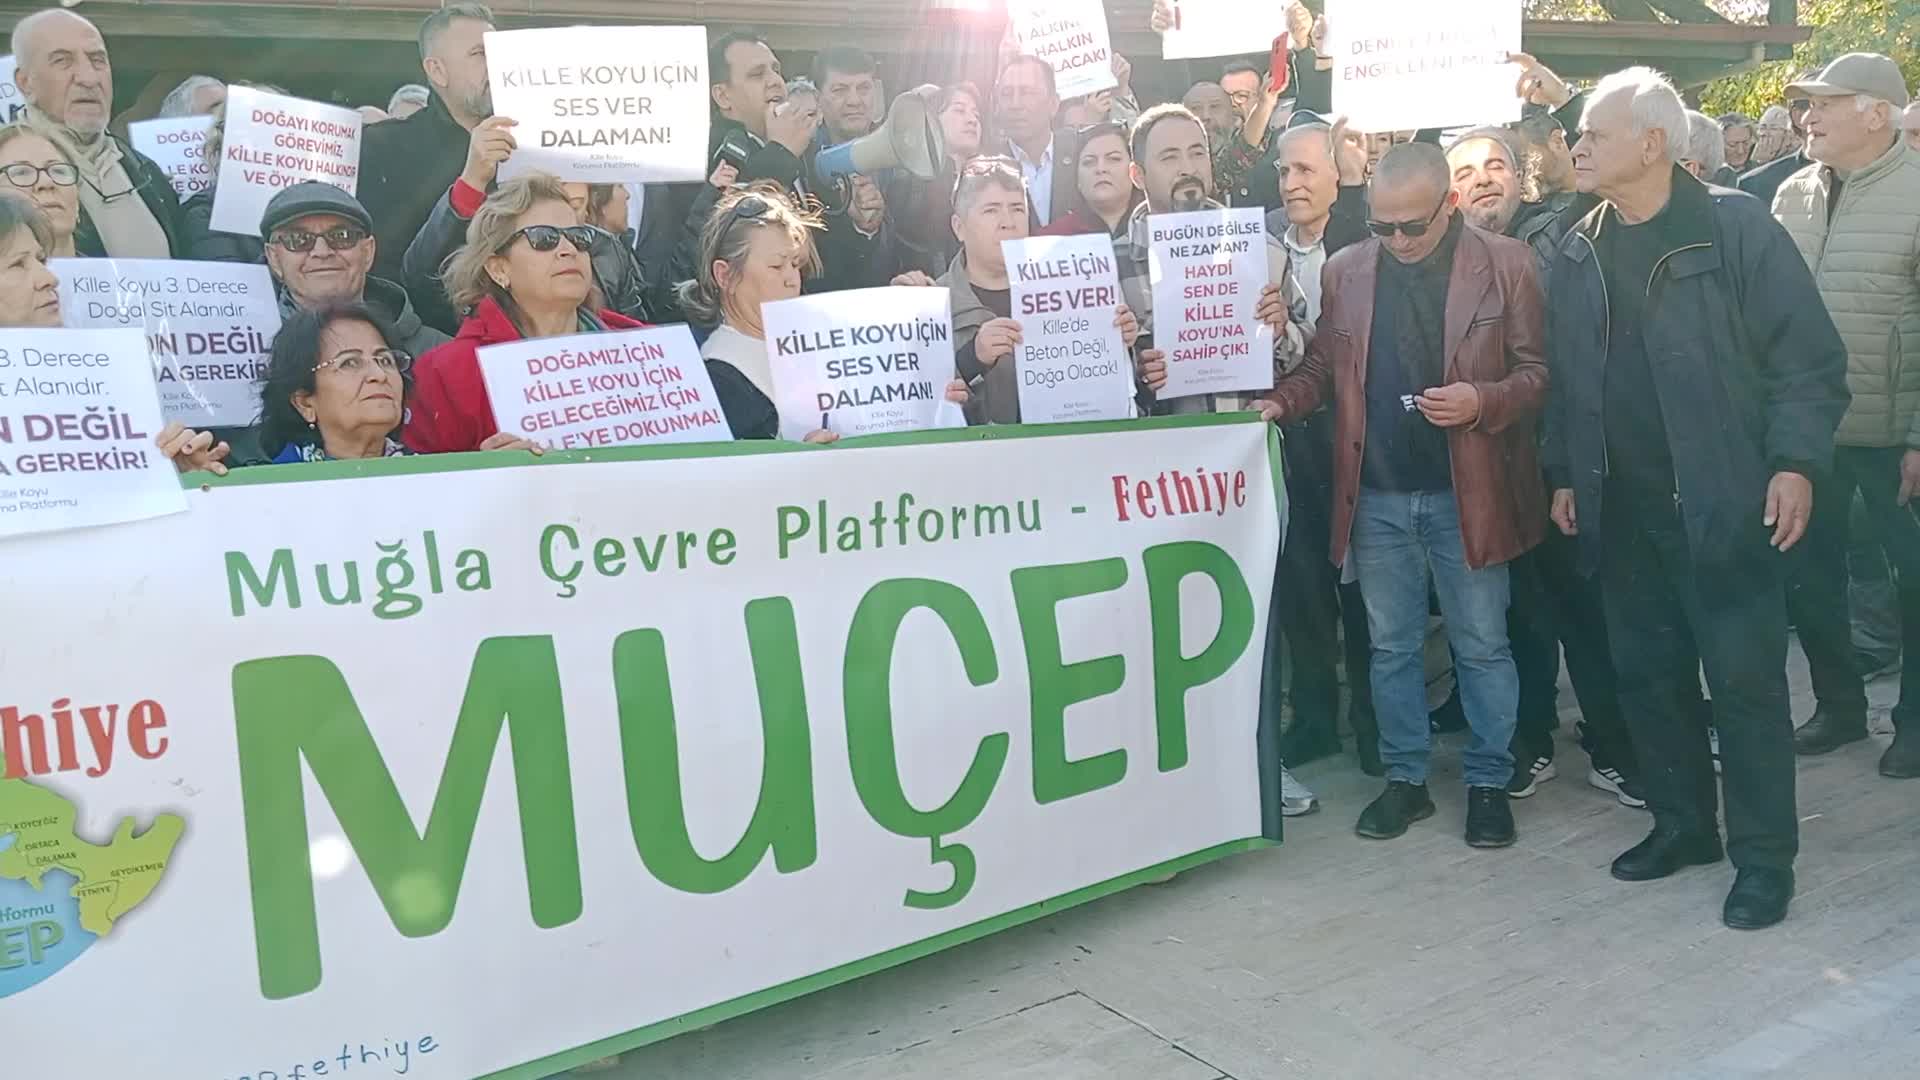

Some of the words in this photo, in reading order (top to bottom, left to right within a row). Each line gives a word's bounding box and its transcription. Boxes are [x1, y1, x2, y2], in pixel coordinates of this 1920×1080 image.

[1034, 32, 1093, 57] HALKIN
[580, 65, 646, 84] KOYU
[553, 98, 600, 116] SES
[605, 97, 652, 115] VER
[252, 109, 308, 131] DOĞAYI
[541, 127, 671, 147] DALAMAN!
[228, 145, 273, 165] KİLLE
[276, 155, 313, 171] KOYU
[243, 170, 265, 185] VE
[1154, 225, 1204, 242] BUGÜN
[1207, 221, 1261, 239] DEĞİLSE
[1170, 247, 1189, 258] NE
[1192, 241, 1249, 256] ZAMAN?
[1017, 258, 1071, 281] KİLLE
[1071, 252, 1111, 280] İÇİN
[1185, 260, 1233, 279] HAYDİ
[73, 276, 111, 293] Kille
[118, 277, 161, 298] Koyu
[187, 278, 248, 294] Derece
[1184, 286, 1214, 298] SEN
[1218, 282, 1238, 295] DE
[1021, 290, 1062, 315] SES
[1066, 285, 1116, 310] VER!
[88, 301, 145, 323] Doğal
[152, 301, 176, 317] Sit
[1185, 303, 1233, 322] KİLLE
[776, 329, 846, 356] KİLLE
[850, 322, 913, 346] KOYU
[915, 317, 947, 347] İÇİN
[1042, 317, 1089, 335] Kille'de
[1178, 324, 1244, 343] KOYU'NA
[187, 325, 272, 354] DEĞİL
[23, 348, 109, 367] Derece
[526, 348, 624, 376] DOĞAMIZ
[624, 340, 665, 365] İÇİN
[1025, 345, 1068, 361] Beton
[1172, 344, 1217, 362] SAHİP
[1220, 343, 1249, 360] ÇIK!
[826, 356, 874, 380] SES
[876, 352, 920, 373] VER
[1024, 368, 1065, 389] Doğa
[1067, 361, 1118, 380] Olacak!
[14, 376, 110, 396] Alanıdır.
[523, 379, 585, 404] KİLLE
[587, 372, 640, 393] KOYU
[641, 364, 683, 389] İÇİN
[817, 381, 933, 412] DALAMAN!
[520, 391, 661, 433] GELECEĞİMİZ
[657, 385, 701, 411] İÇİN
[23, 405, 147, 442] DEĞİL
[614, 408, 722, 441] DOKUNMA!
[16, 446, 149, 474] GEREKİR!
[226, 532, 491, 618] Muğla
[543, 524, 737, 598] Çevre
[778, 493, 1040, 559] Platformu
[1114, 468, 1246, 522] Fethiye
[231, 540, 1256, 1000] MUÇEP
[36, 851, 77, 864] DALAMAN
